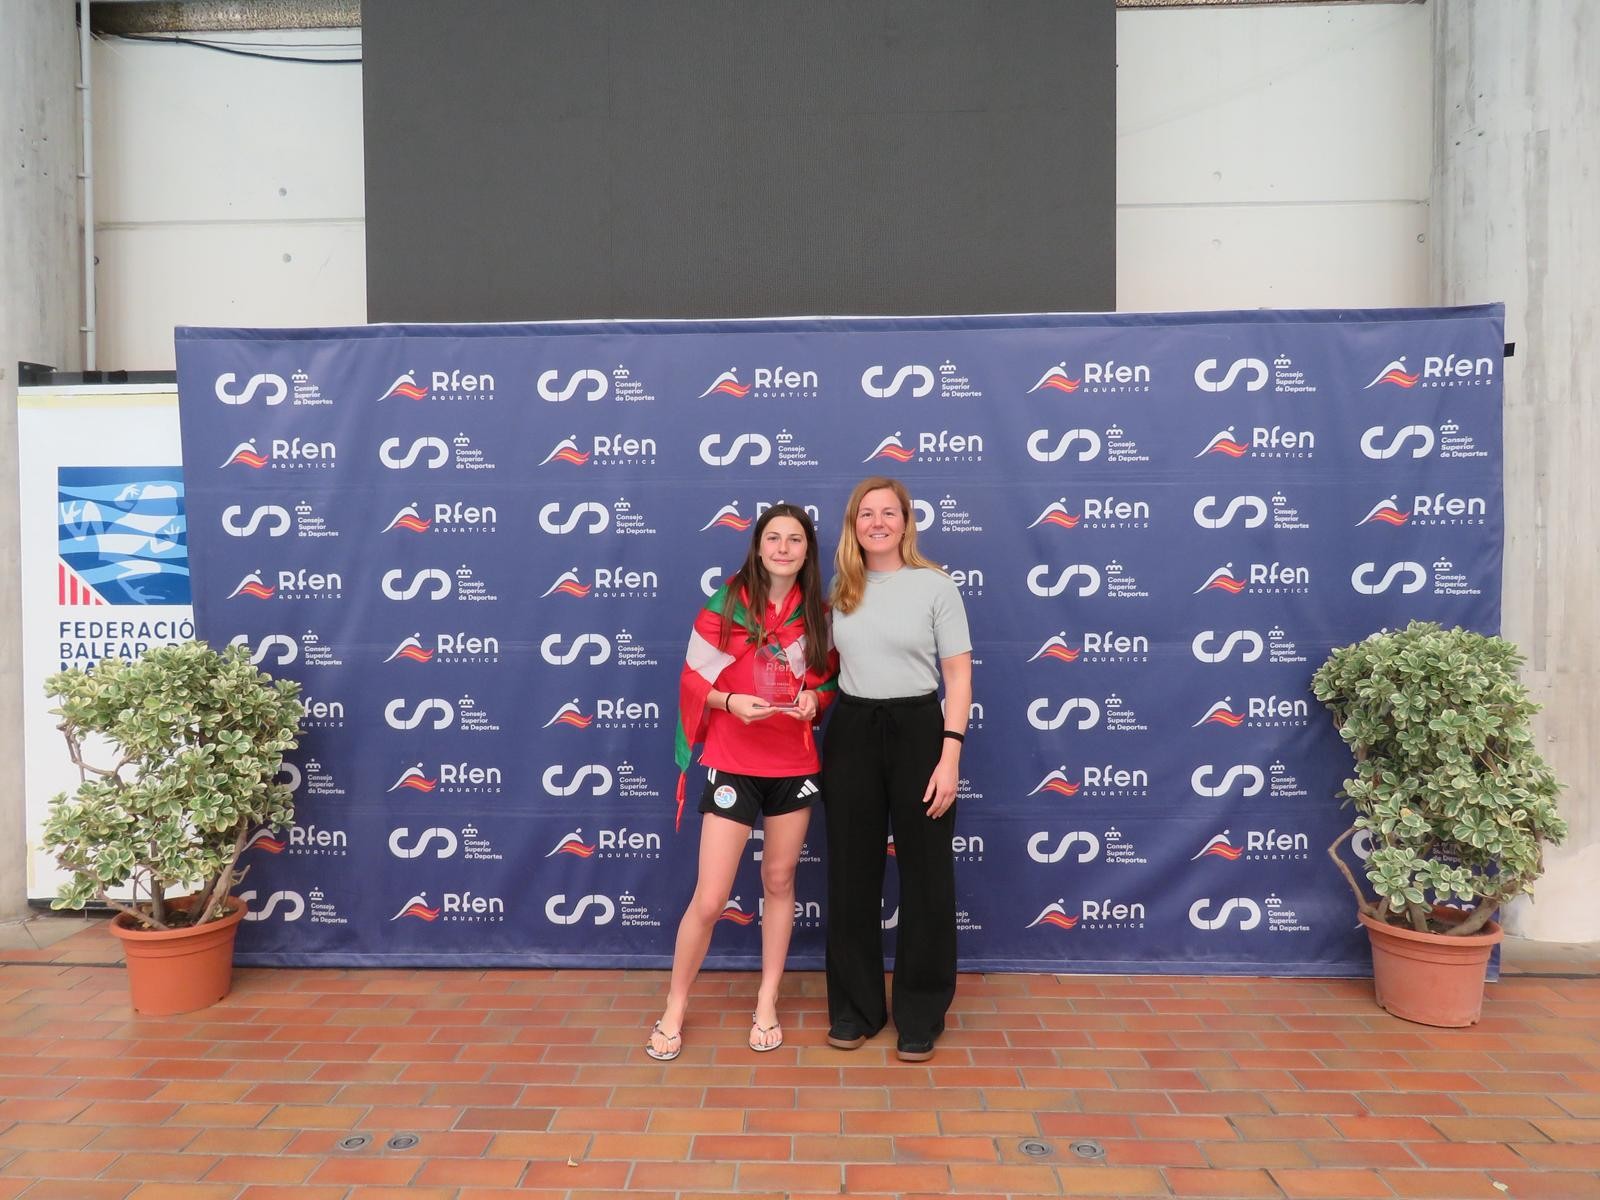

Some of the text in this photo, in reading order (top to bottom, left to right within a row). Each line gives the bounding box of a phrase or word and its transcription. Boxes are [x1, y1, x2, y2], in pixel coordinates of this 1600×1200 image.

[1085, 361, 1150, 383] Rfen
[1424, 354, 1493, 377] Rfen
[432, 370, 494, 391] Rfen
[755, 366, 817, 388] Rfen
[594, 434, 656, 456] Rfen
[920, 430, 982, 452] Rfen
[1253, 426, 1314, 448] Rfen
[1441, 436, 1472, 445] Consejo
[273, 438, 335, 459] Rfen
[436, 502, 496, 523] Rfen
[1085, 497, 1149, 519] Rfen
[1414, 493, 1485, 515] Rfen
[279, 569, 341, 590] Rfen
[596, 567, 657, 588] Rfen
[1251, 562, 1308, 584] Rfen
[60, 618, 194, 639] FEDERACIÓ
[438, 632, 498, 654] Rfen
[1084, 631, 1148, 652] Rfen
[302, 697, 344, 718] fen
[598, 698, 658, 719] Rfen
[1249, 696, 1307, 717] Rfen
[441, 763, 500, 784] Rfen
[1084, 765, 1147, 786] Rfen
[290, 825, 346, 846] Rfen
[600, 828, 660, 849] Rfen
[952, 835, 984, 852] en
[1248, 829, 1307, 850] Rfen
[444, 892, 503, 913] Rfen
[1083, 899, 1144, 920] Rfen
